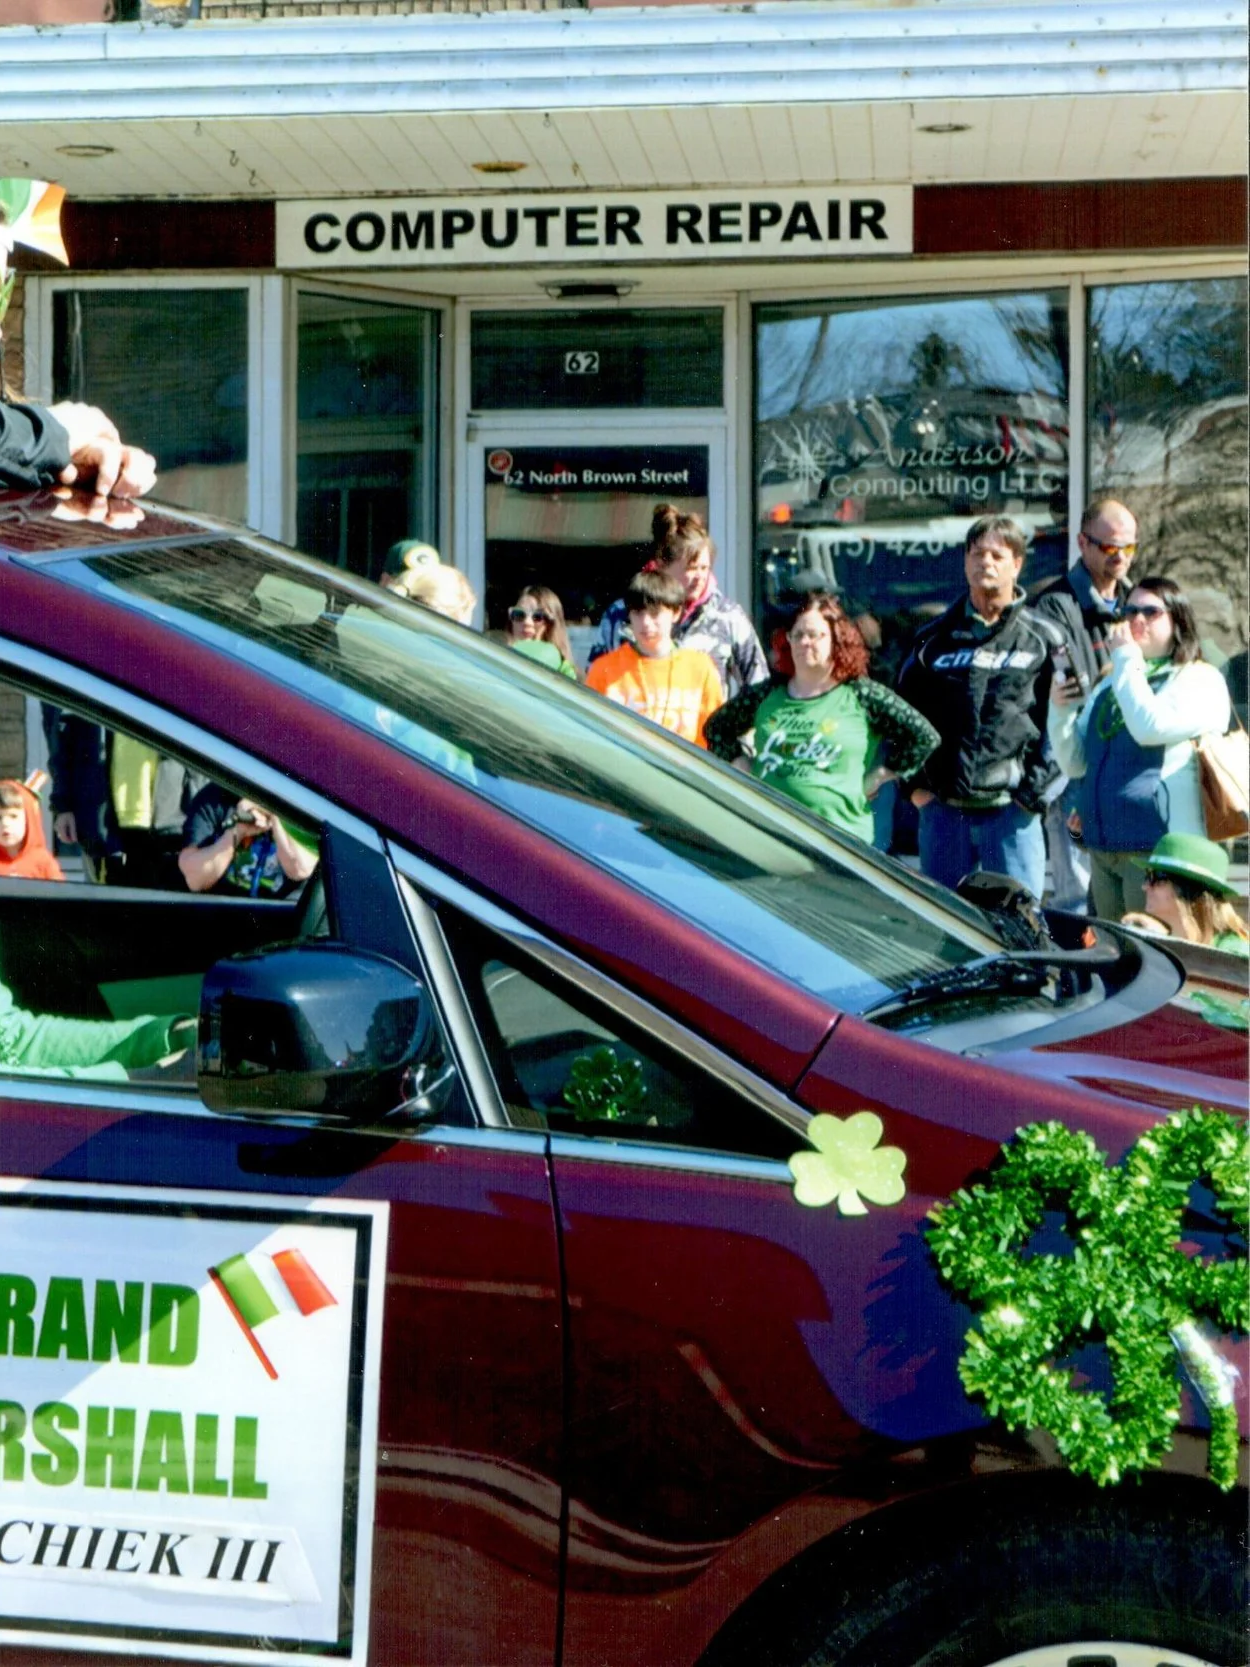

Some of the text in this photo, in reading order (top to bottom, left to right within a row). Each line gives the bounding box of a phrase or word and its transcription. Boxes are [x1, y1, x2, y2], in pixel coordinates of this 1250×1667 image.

[303, 198, 889, 254] COMPUTER REPAIR
[567, 352, 598, 373] 62
[859, 432, 1028, 468] Anderson
[504, 467, 690, 485] 62 North Brown Street
[829, 468, 1063, 500] Computing LLC
[758, 730, 843, 779] Lcky
[206, 1537, 284, 1584] III
